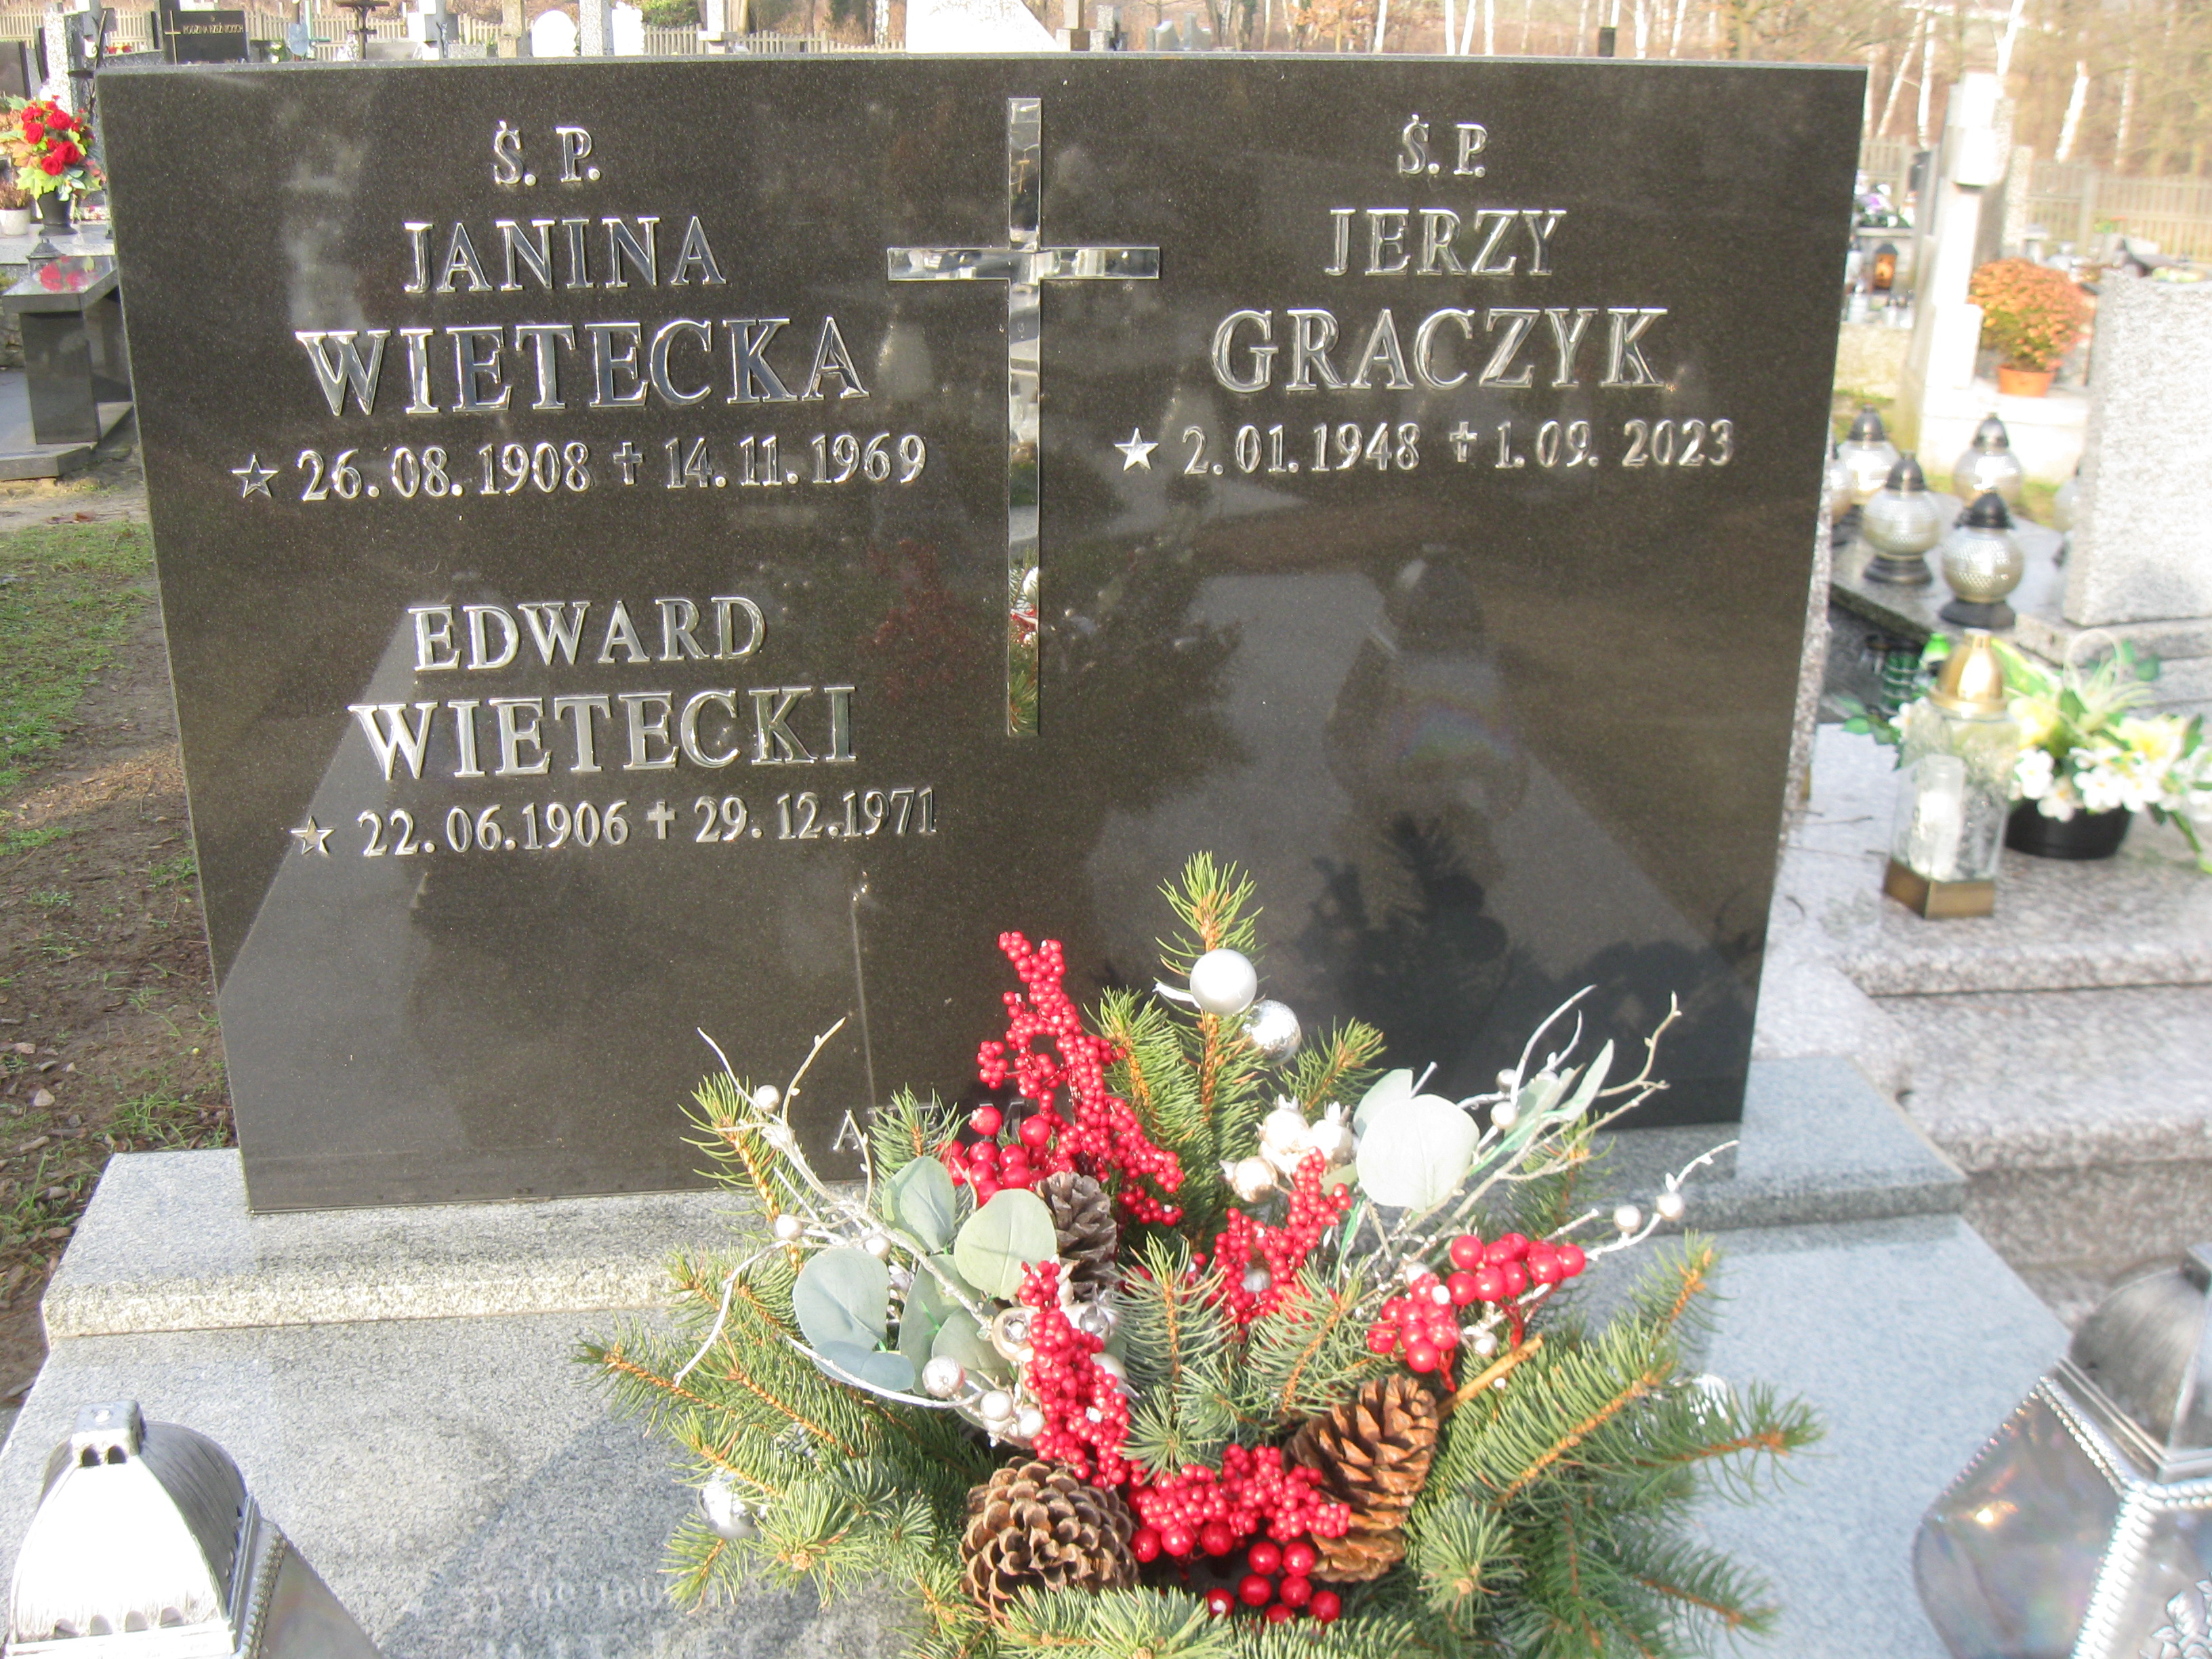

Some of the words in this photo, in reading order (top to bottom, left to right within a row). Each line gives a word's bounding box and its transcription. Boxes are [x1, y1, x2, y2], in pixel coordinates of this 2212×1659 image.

[555, 126, 600, 182] P.
[1454, 123, 1488, 177] P.
[403, 215, 726, 293] JANINA
[1325, 209, 1567, 276] JERZY
[295, 316, 869, 417] WIETECKA
[1210, 308, 1668, 392] GRACZYK
[407, 596, 767, 672] EDWARD
[348, 686, 857, 781] WIETECKI
